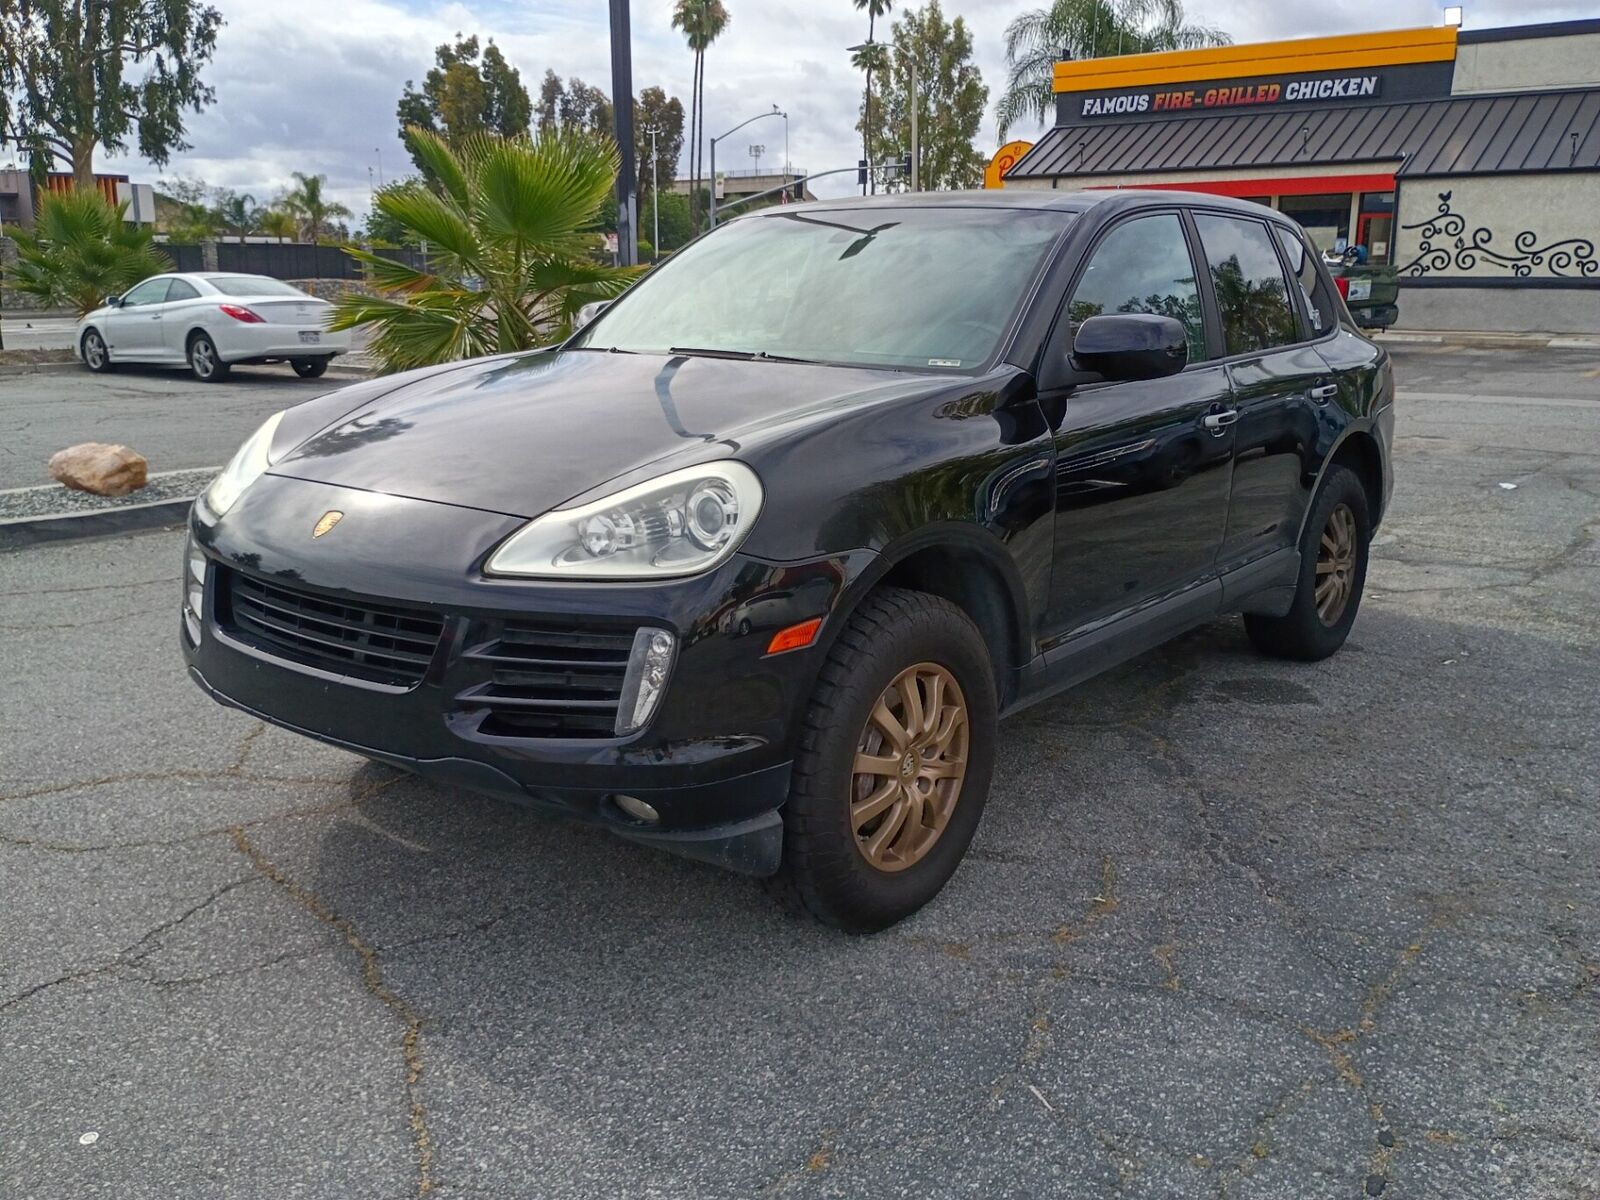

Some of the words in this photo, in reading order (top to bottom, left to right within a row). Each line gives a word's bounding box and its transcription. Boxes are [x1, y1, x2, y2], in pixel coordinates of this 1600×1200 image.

[1081, 94, 1150, 115] FAMOUS
[1152, 83, 1281, 112] FIRE-GRILLED
[1285, 76, 1378, 101] CHICKEN
